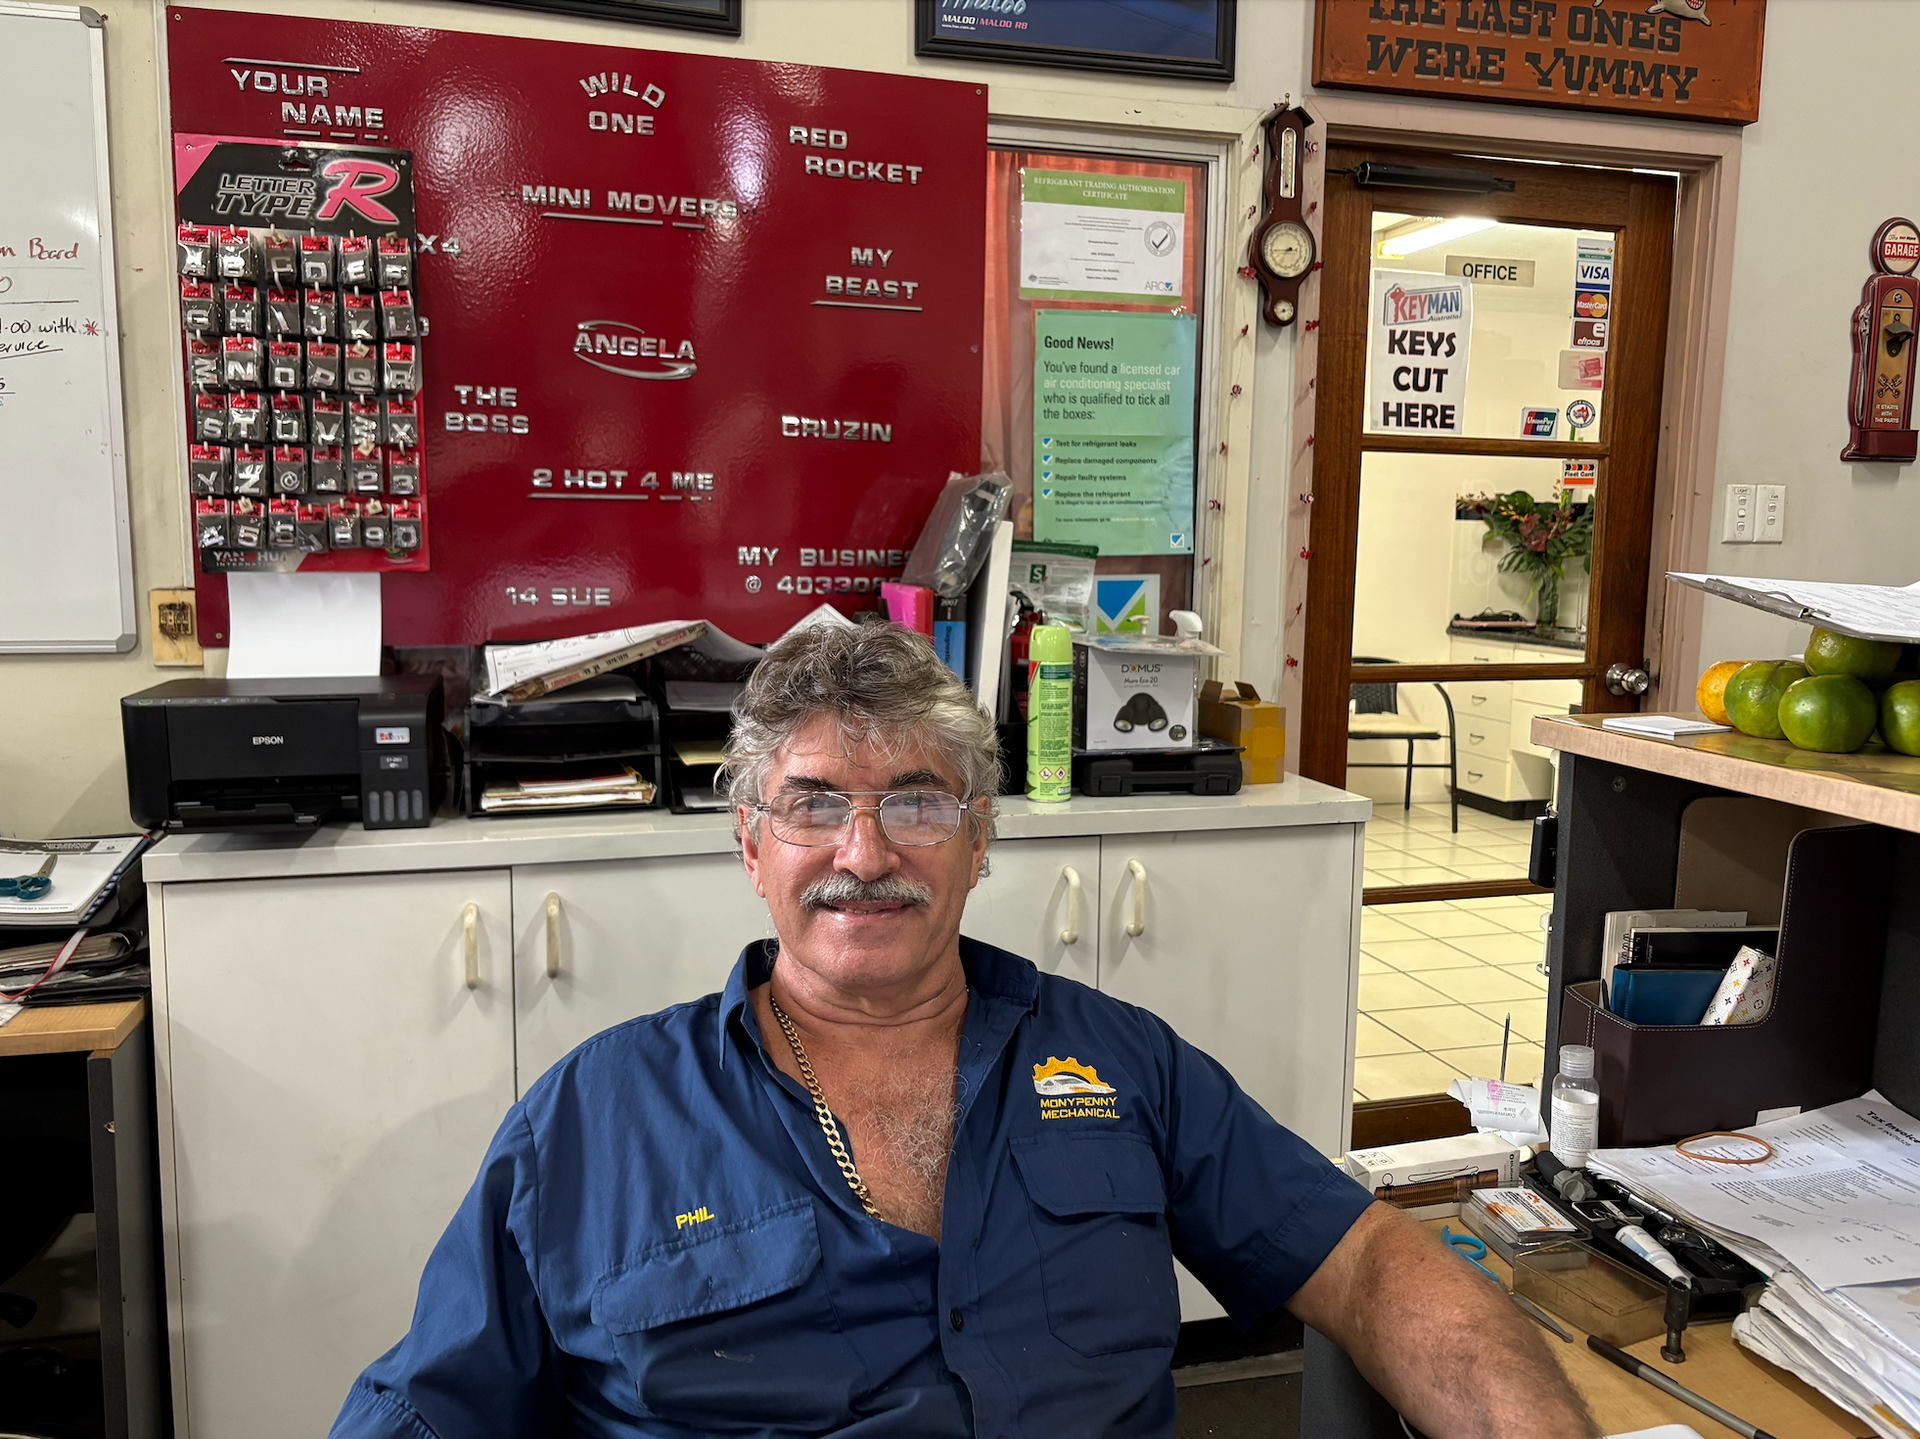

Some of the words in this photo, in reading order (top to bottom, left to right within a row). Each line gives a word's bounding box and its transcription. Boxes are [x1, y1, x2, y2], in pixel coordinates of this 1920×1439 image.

[941, 14, 976, 25] MALOO
[979, 18, 1013, 28] MALOO
[1369, 0, 1446, 29] THE
[1456, 0, 1557, 38] LAST
[1567, 5, 1682, 52] ONES
[1366, 34, 1506, 81] WERE
[1524, 47, 1698, 99] YUMMY
[231, 69, 329, 98] YOUR
[579, 72, 666, 108] WILD
[281, 101, 385, 129] NAME
[588, 110, 655, 136] ONE
[788, 125, 848, 150] RED
[805, 155, 923, 185] ROCKET
[216, 190, 314, 219] TYPE
[317, 158, 400, 224] R
[220, 174, 316, 195] LETTER
[1033, 176, 1084, 189] REFRIGERANT
[1084, 180, 1117, 191] TRADING
[1117, 183, 1176, 196] AUTHORISATION
[1082, 189, 1129, 202] CERTIFICATE
[521, 184, 592, 209] MINI
[607, 190, 738, 220] MOVERS
[28, 237, 79, 260] Board
[851, 246, 893, 268] MY
[1884, 243, 1919, 257] GARAGE
[222, 254, 245, 278] B
[271, 256, 294, 273] C
[304, 261, 328, 280] D
[347, 260, 366, 281] E
[1462, 262, 1518, 281] OFFICE
[1580, 264, 1610, 280] VISA
[825, 275, 919, 300] BEAST
[1144, 280, 1166, 292] ARC
[1393, 289, 1460, 323] KEYMAN
[1576, 301, 1607, 310] MasterCard
[39, 317, 77, 334] with
[229, 307, 252, 331] H
[306, 315, 327, 335] J
[350, 319, 373, 339] K
[388, 316, 408, 336] L
[573, 332, 697, 360] ANGELA
[1044, 335, 1074, 350] Good
[1077, 337, 1115, 351] News!
[1388, 328, 1457, 358] KEYS
[1577, 336, 1602, 346] eftpos
[228, 360, 254, 381] N
[347, 367, 371, 386] Q
[1043, 360, 1078, 374] You've
[1080, 361, 1108, 375] found
[1111, 364, 1118, 375] a
[1120, 363, 1162, 376] licensed
[1164, 365, 1182, 376] car
[1392, 365, 1449, 393] CUT
[453, 384, 518, 408] THE
[1043, 377, 1057, 389] air
[1060, 377, 1122, 393] conditioning
[1123, 379, 1171, 392] specialist
[1043, 393, 1066, 405] who
[1068, 393, 1078, 405] is
[1080, 393, 1123, 407] qualified
[1125, 395, 1136, 405] to
[1138, 394, 1156, 406] tick
[1158, 395, 1170, 406] all
[444, 411, 530, 435] BOSS
[1043, 408, 1060, 420] the
[1062, 409, 1096, 421] boxes:
[1382, 401, 1456, 430] HERE
[203, 417, 224, 439] S
[232, 416, 256, 438] T
[391, 422, 414, 444] X
[780, 415, 893, 443] CRUZIN
[1082, 440, 1118, 448] refrigerant
[1055, 457, 1082, 465] Replace
[1083, 457, 1114, 465] damaged
[197, 471, 219, 493] Y
[280, 471, 301, 492] @
[357, 470, 379, 491] 2
[392, 473, 414, 495] 3
[531, 468, 553, 488] 2
[563, 469, 629, 490] HOT
[640, 469, 660, 490] 4
[671, 471, 715, 491] ME
[1055, 474, 1077, 482] Repair
[1078, 474, 1098, 482] faulty
[1099, 474, 1127, 482] systems
[1095, 491, 1131, 499] refrigerant
[238, 524, 260, 547] 5
[365, 526, 385, 546] 9
[738, 545, 779, 567] MY
[1032, 566, 1043, 580] S
[744, 575, 763, 594] @
[505, 586, 539, 606] 14
[550, 587, 611, 607] SUE
[252, 736, 284, 746] EPSON
[1040, 1096, 1118, 1109] MONYPENNY
[1041, 1107, 1121, 1120] MECHANICAL
[675, 1206, 715, 1230] PHIL
